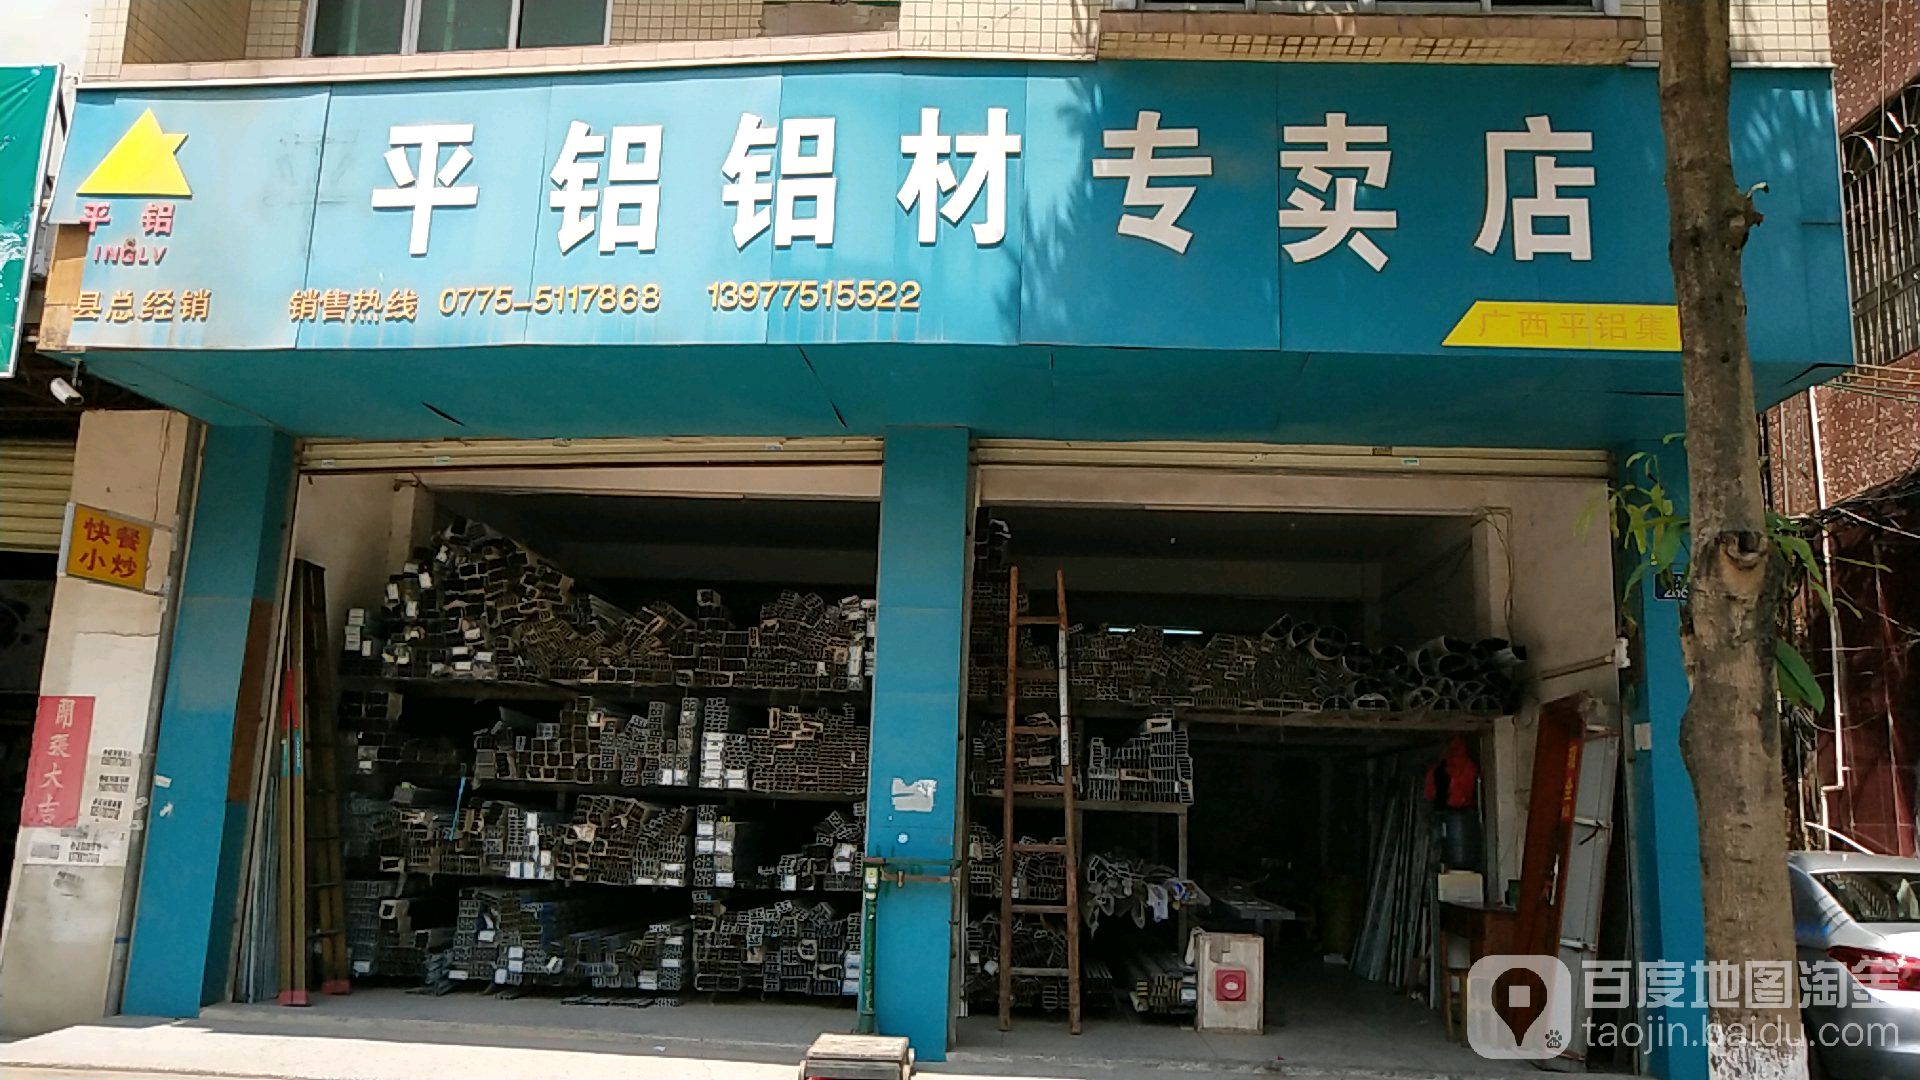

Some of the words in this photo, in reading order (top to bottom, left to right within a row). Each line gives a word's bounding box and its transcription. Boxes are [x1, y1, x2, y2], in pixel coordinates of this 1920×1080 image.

[371, 107, 1595, 272] 平铝铝材专卖店
[79, 202, 175, 236] 平铝
[71, 288, 212, 321] 县总经销
[289, 289, 418, 322] 销售热线
[439, 284, 660, 315] 0775-5117868
[707, 280, 921, 311] 13977515522
[83, 517, 140, 551] 快餐
[79, 548, 137, 578] 小炒
